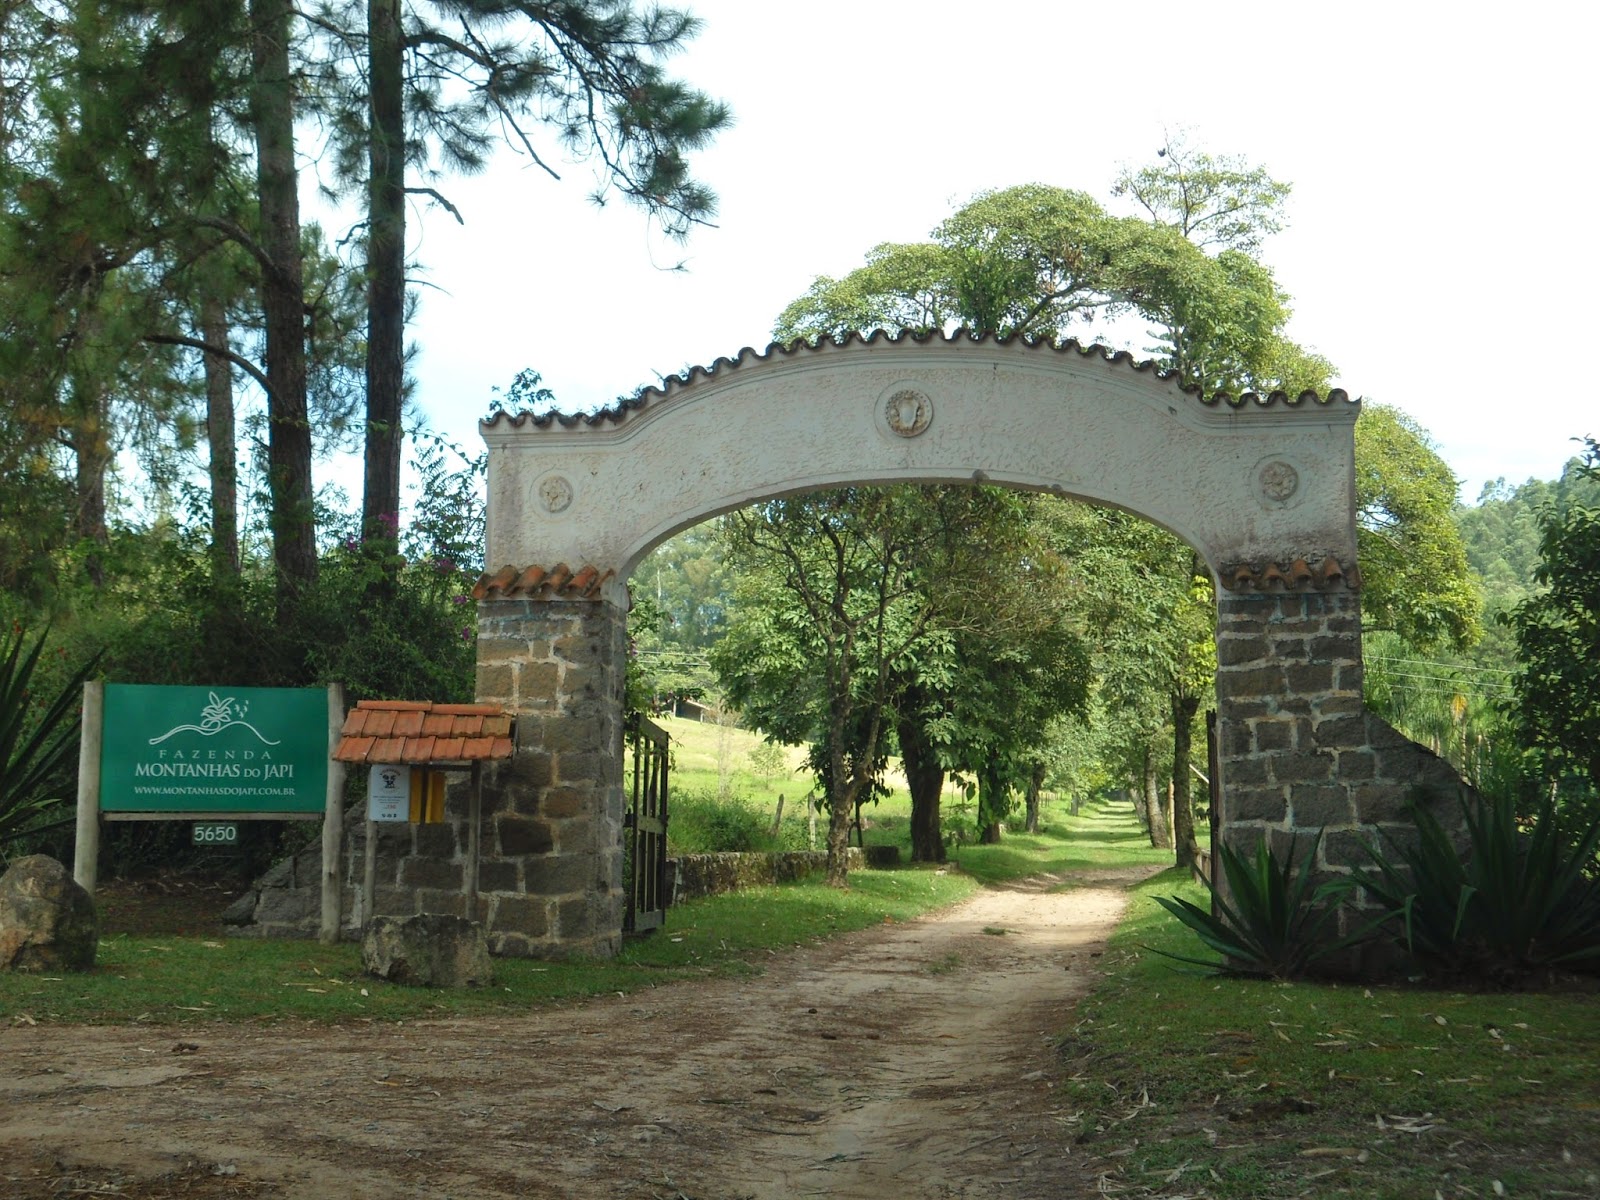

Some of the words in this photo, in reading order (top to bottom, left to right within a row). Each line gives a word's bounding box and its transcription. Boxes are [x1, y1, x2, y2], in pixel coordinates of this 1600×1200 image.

[159, 749, 272, 760] FAZENDA
[135, 763, 240, 778] MONTANHAS
[263, 764, 294, 781] JAPI
[134, 786, 295, 796] WWW.MONTANHASDOJAPI.COM.BR
[194, 826, 237, 842] 5650
